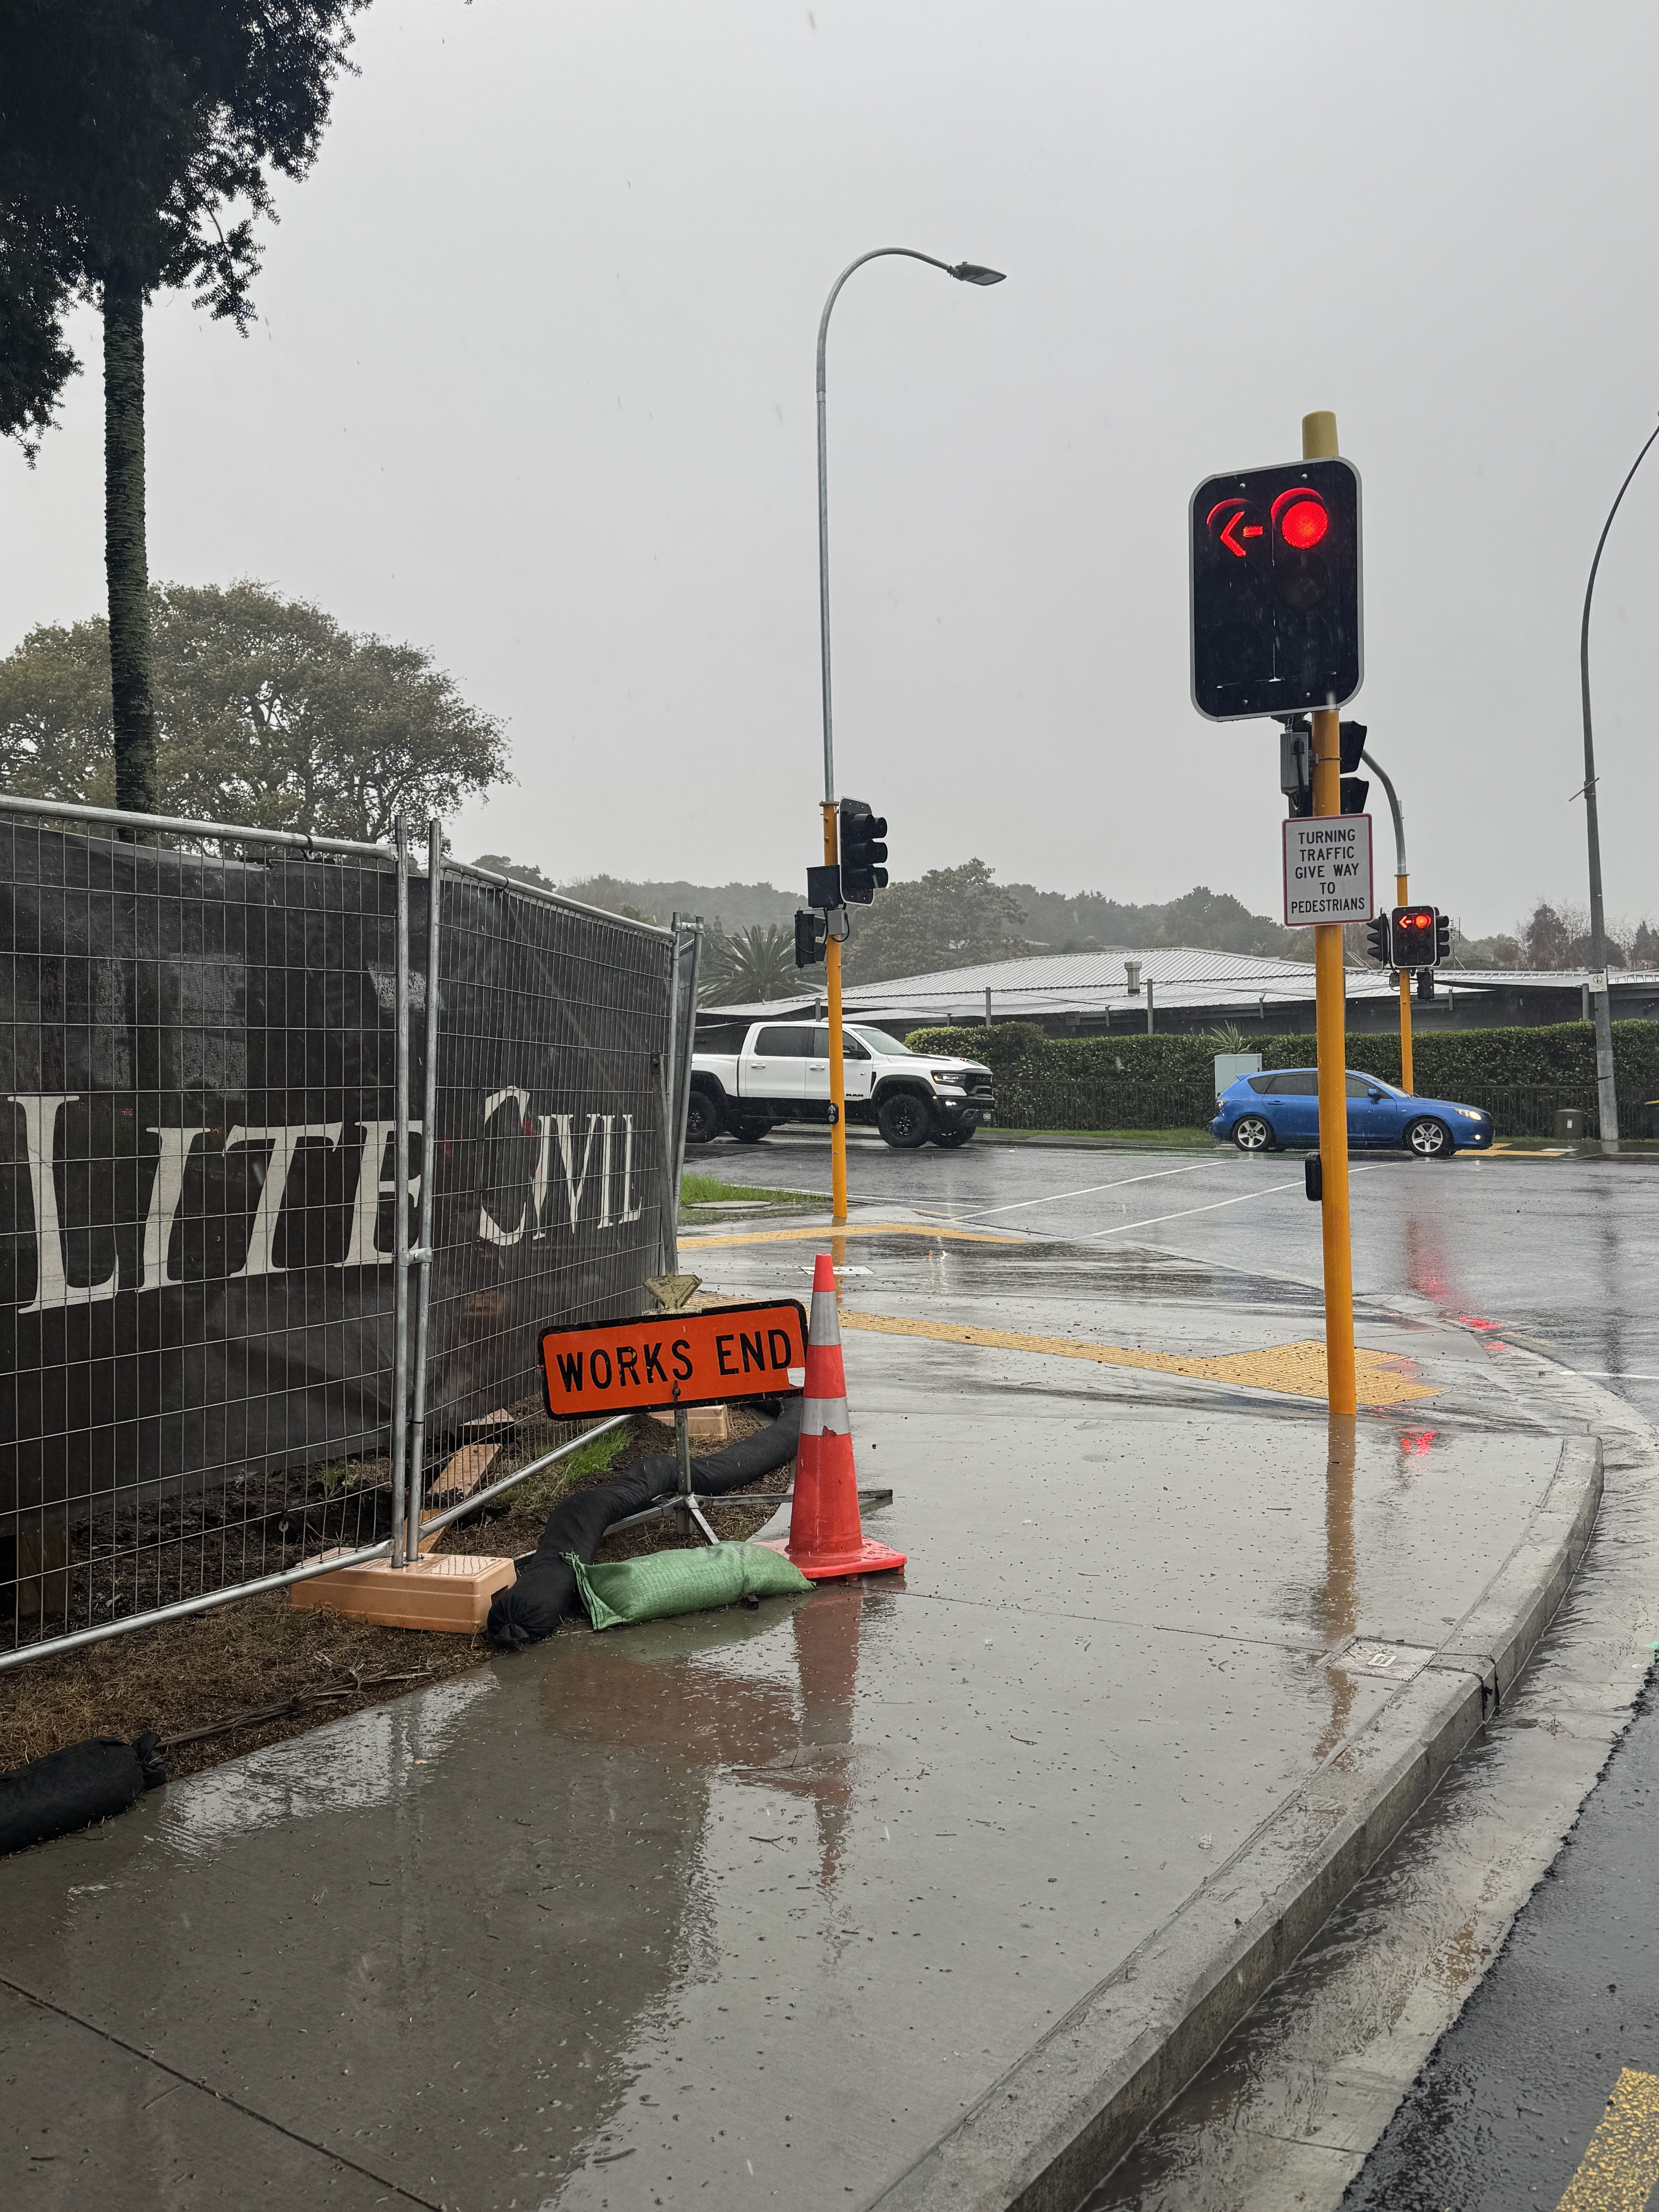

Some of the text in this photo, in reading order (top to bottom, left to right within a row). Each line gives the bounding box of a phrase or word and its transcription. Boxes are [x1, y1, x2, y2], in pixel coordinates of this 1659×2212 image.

[1298, 829, 1355, 845] TURNING
[1300, 846, 1354, 862] TRAFFIC
[1295, 863, 1359, 879] GIVE WAY
[1319, 882, 1336, 895] TO
[1291, 897, 1365, 914] PEDESTRIANS
[556, 1329, 791, 1393] WORKS END
